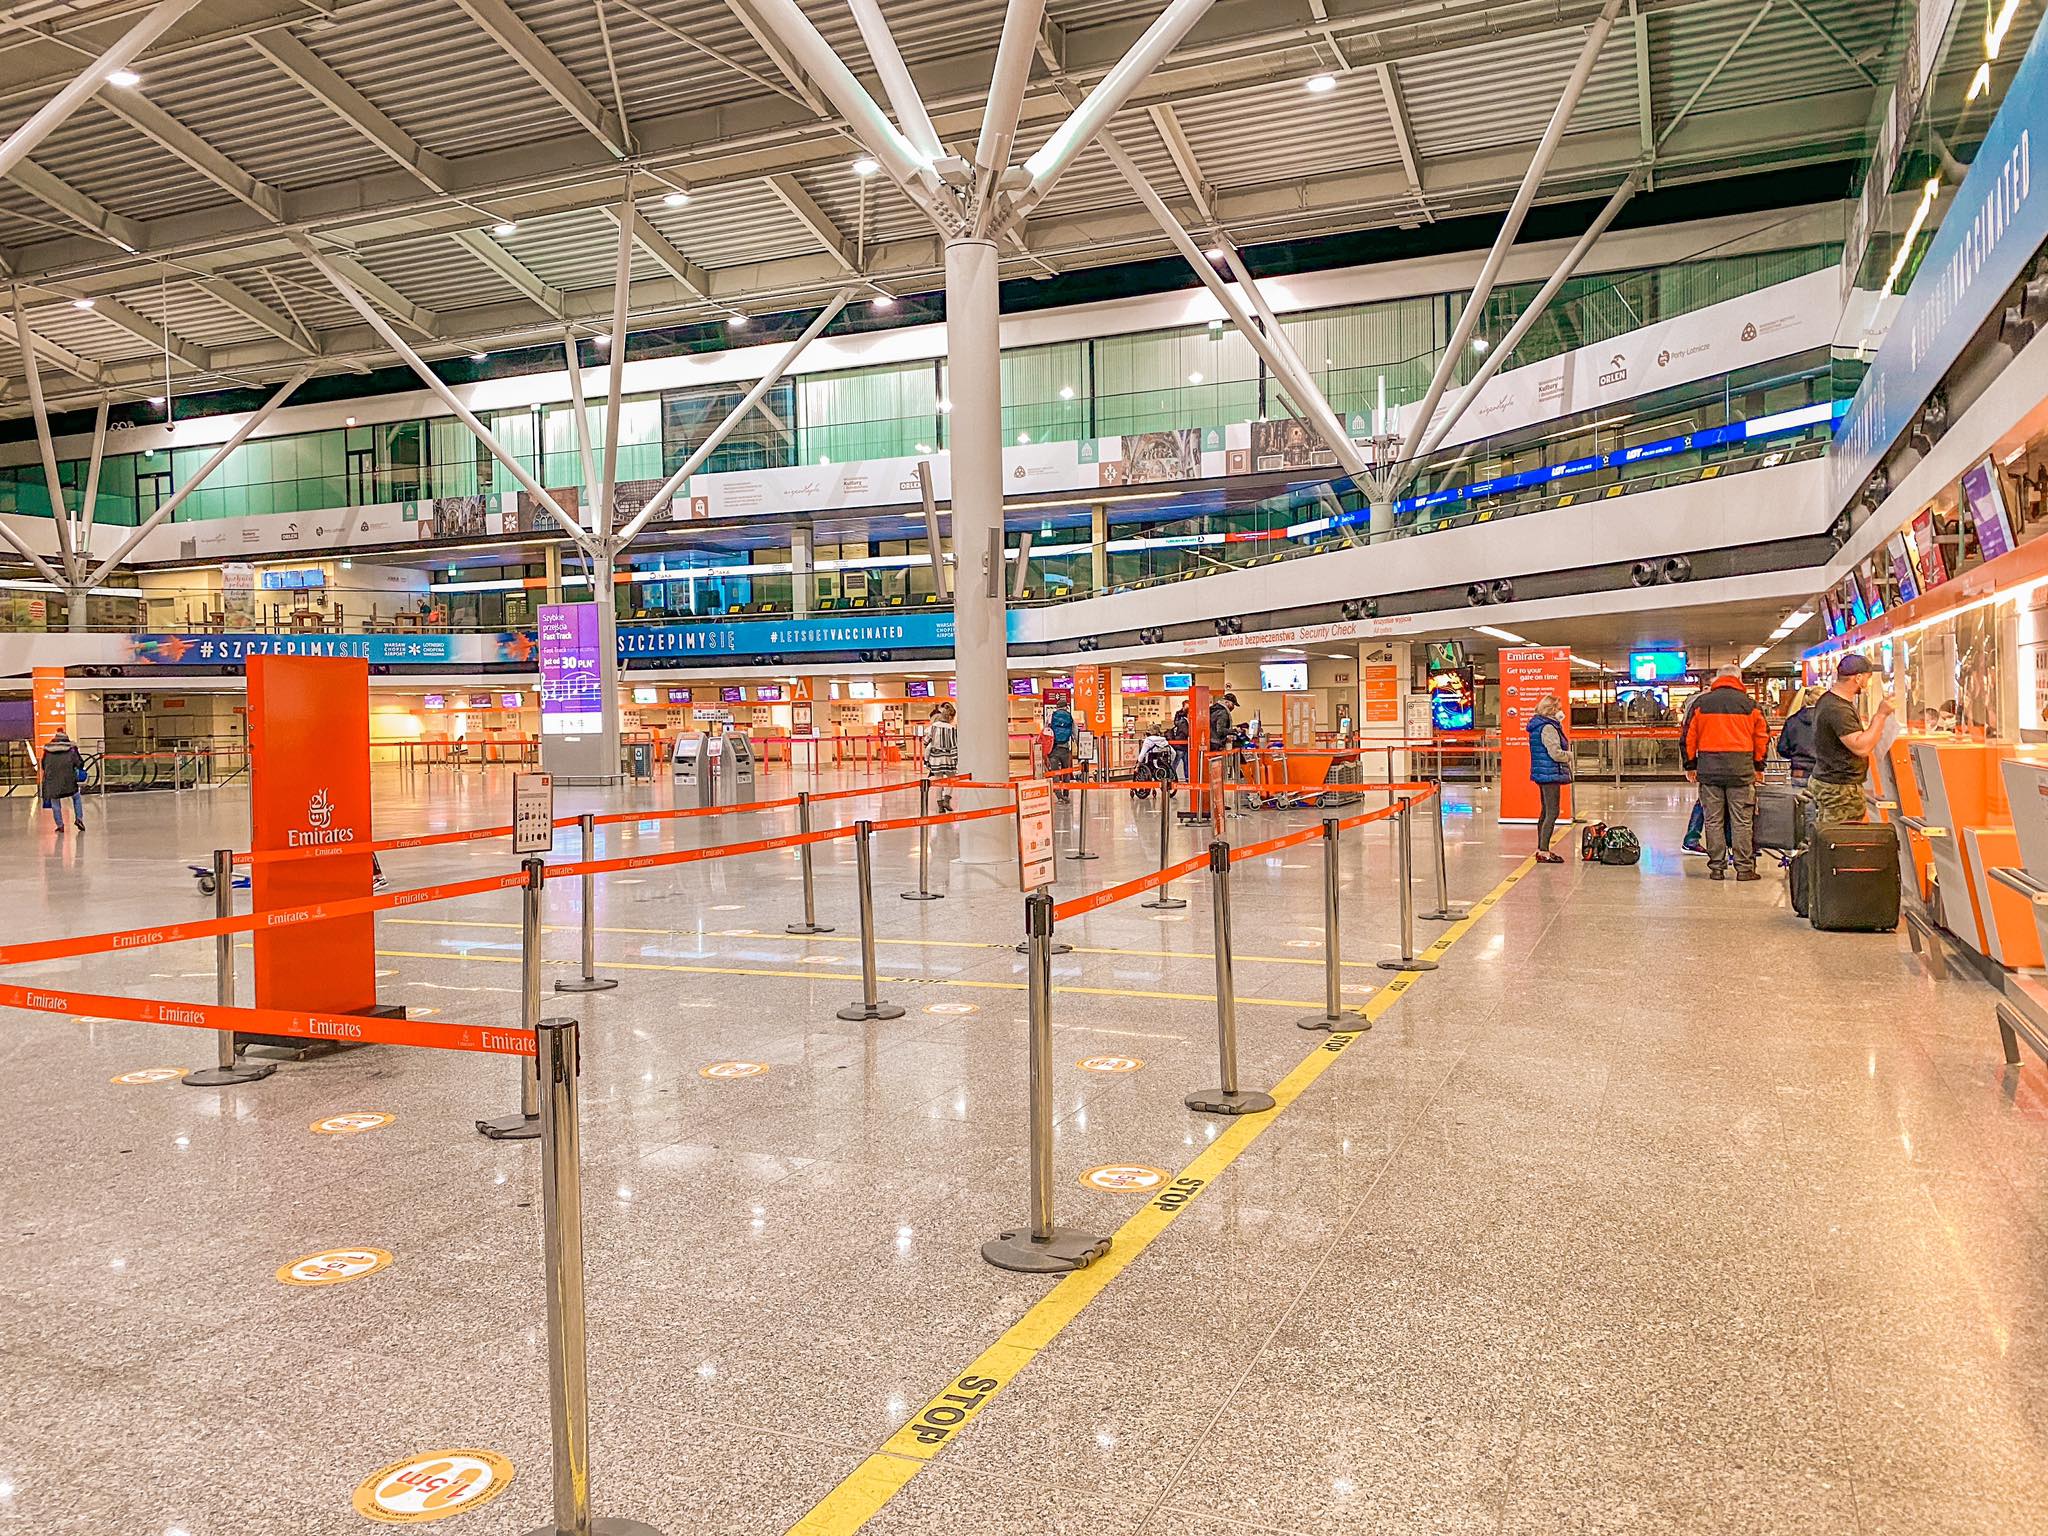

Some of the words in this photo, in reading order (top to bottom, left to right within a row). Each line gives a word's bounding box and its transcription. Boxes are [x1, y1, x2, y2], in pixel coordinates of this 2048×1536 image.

[1600, 370, 1625, 386] ORLEN
[900, 482, 921, 490] ORLE
[556, 631, 572, 640] Track
[1218, 634, 1244, 648] Kontrola
[1299, 627, 1329, 641] Security
[1331, 623, 1357, 637] Check
[561, 656, 577, 669] 30
[1506, 652, 1545, 661] Emirates
[795, 679, 808, 699] A
[1095, 667, 1107, 723] Check-in
[288, 827, 354, 847] Emirates
[396, 839, 422, 848] Emirates
[315, 847, 343, 856] Emirates
[702, 847, 725, 857] Emirates
[629, 857, 655, 867] Emirates
[545, 866, 574, 877] Emirates
[394, 890, 429, 905] Emirates
[1096, 892, 1114, 906] Emirates
[267, 910, 309, 926] Emirates
[113, 931, 164, 948] Emirates
[1389, 981, 1409, 992] STOP
[26, 991, 68, 1011] Emirates
[159, 1005, 205, 1024] Emirates
[309, 1018, 362, 1038] Emirates
[481, 1031, 537, 1053] Emirate
[1322, 1035, 1353, 1052] STOP
[1153, 1177, 1204, 1212] STOP
[912, 1374, 998, 1444] STOP
